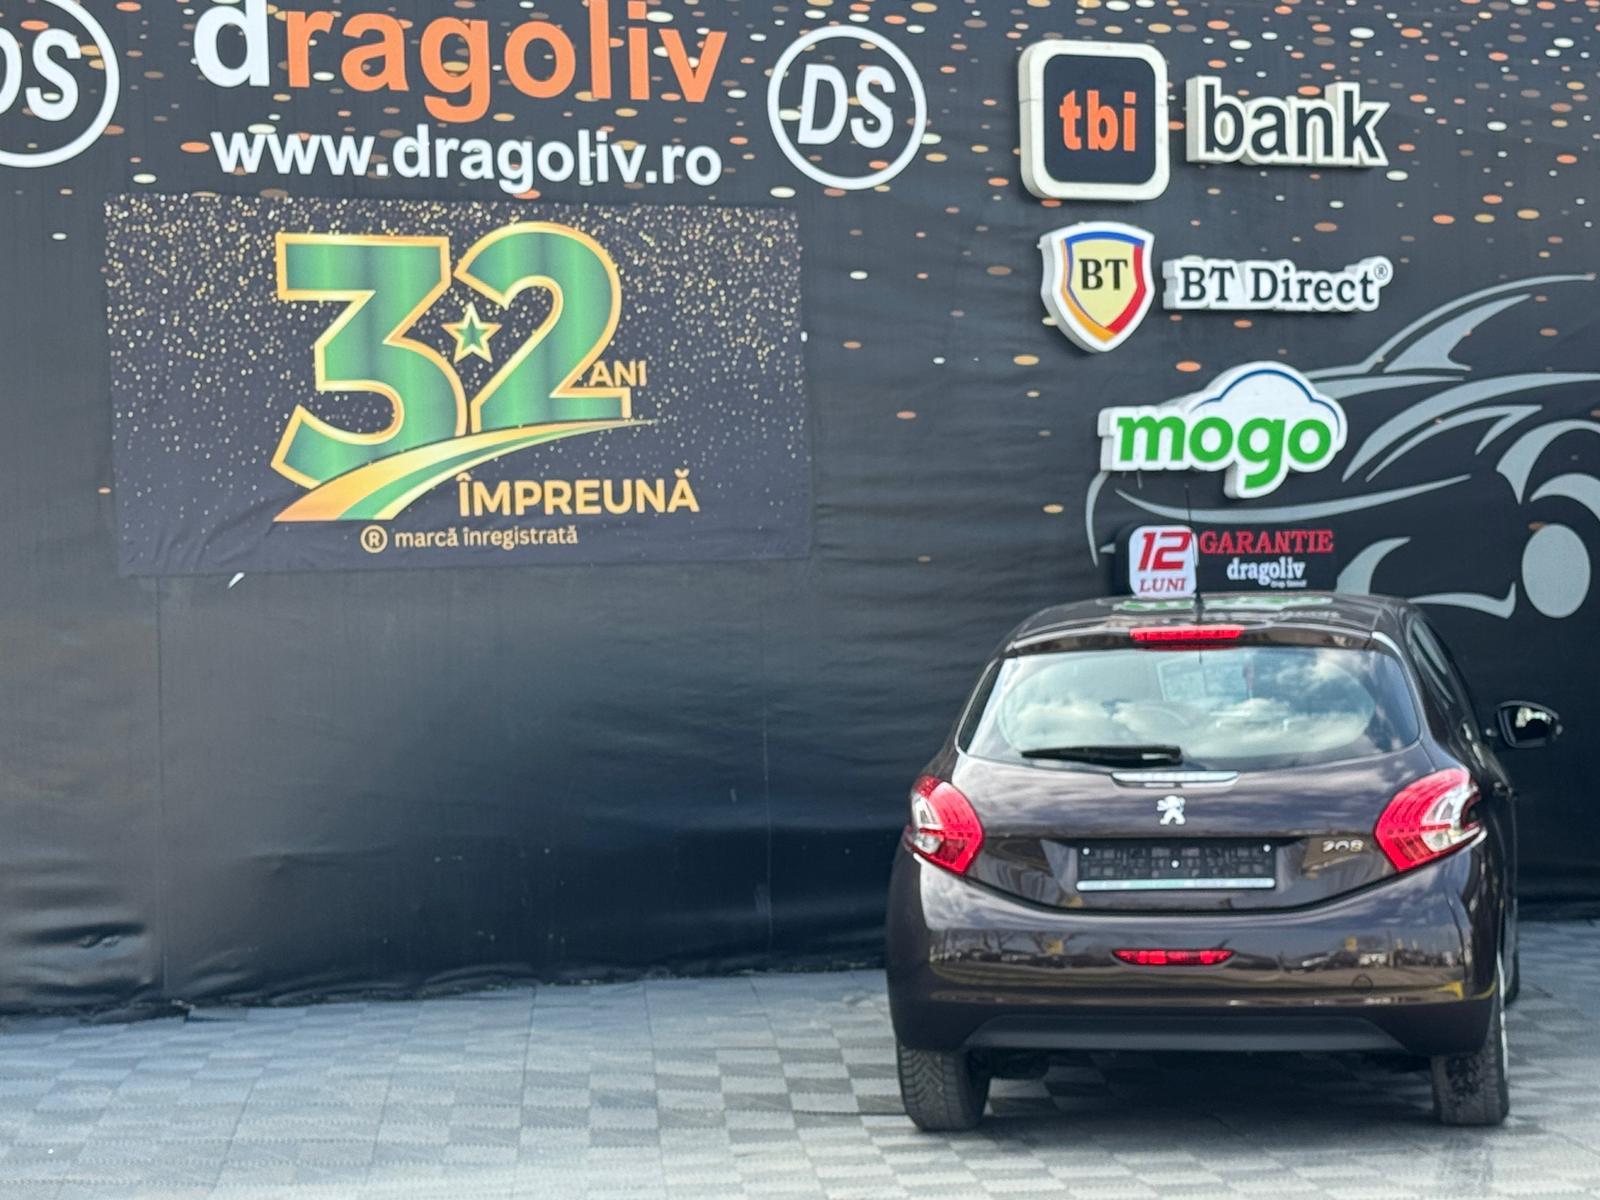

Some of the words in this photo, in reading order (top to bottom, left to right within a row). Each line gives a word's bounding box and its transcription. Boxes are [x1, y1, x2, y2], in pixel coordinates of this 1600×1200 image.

[193, 0, 727, 122] dragoliv
[797, 63, 896, 149] DS
[1059, 89, 1137, 152] tbi
[1203, 83, 1380, 159] bank
[210, 124, 723, 194] www.dragoliv.ro
[1079, 257, 1129, 291] BT
[1180, 264, 1236, 302] BT
[271, 221, 632, 490] 32
[588, 360, 648, 387] ANI
[1117, 416, 1332, 490] mogo
[456, 468, 701, 518] ÎMPREUNĂ
[394, 527, 460, 549] marcă
[462, 523, 579, 552] înregistrată
[1137, 531, 1193, 571] 12
[1199, 529, 1335, 555] GARANTIE
[1139, 577, 1188, 594] LUNI
[1225, 556, 1308, 587] dragoliv
